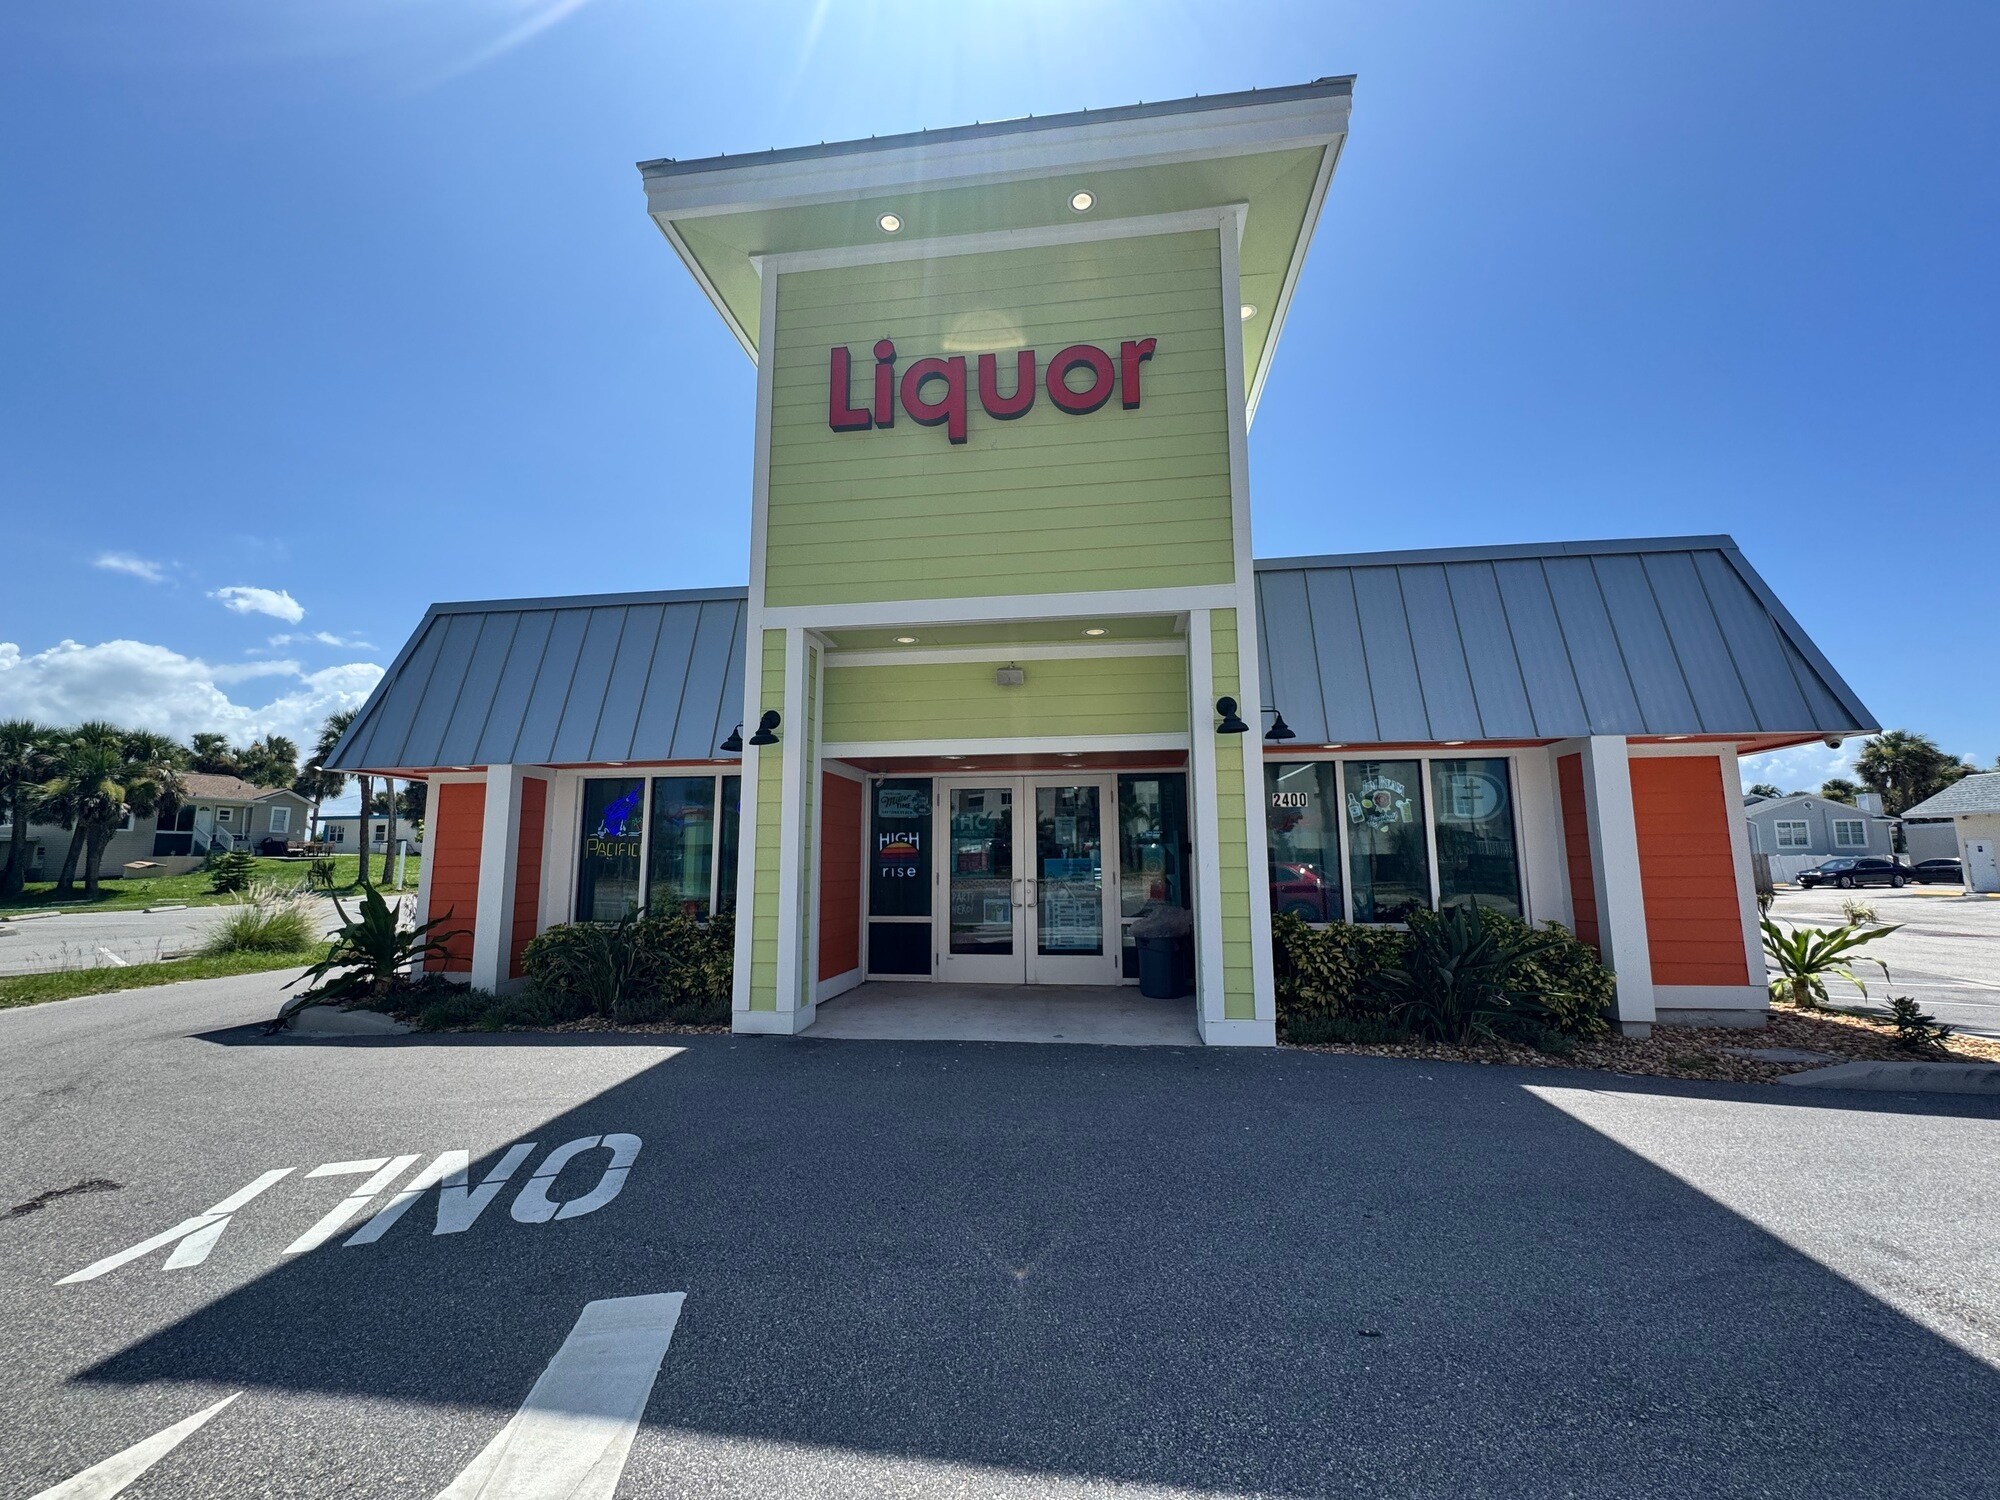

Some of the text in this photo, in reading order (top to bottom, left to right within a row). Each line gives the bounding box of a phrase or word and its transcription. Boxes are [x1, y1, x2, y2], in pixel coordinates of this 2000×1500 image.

[829, 338, 1157, 444] Liquor
[880, 794, 911, 808] Miller
[1273, 793, 1307, 807] 2400
[585, 838, 642, 859] PACIFIC
[879, 832, 920, 851] HIGH
[882, 867, 917, 878] rise
[54, 1133, 643, 1285] ONLY
